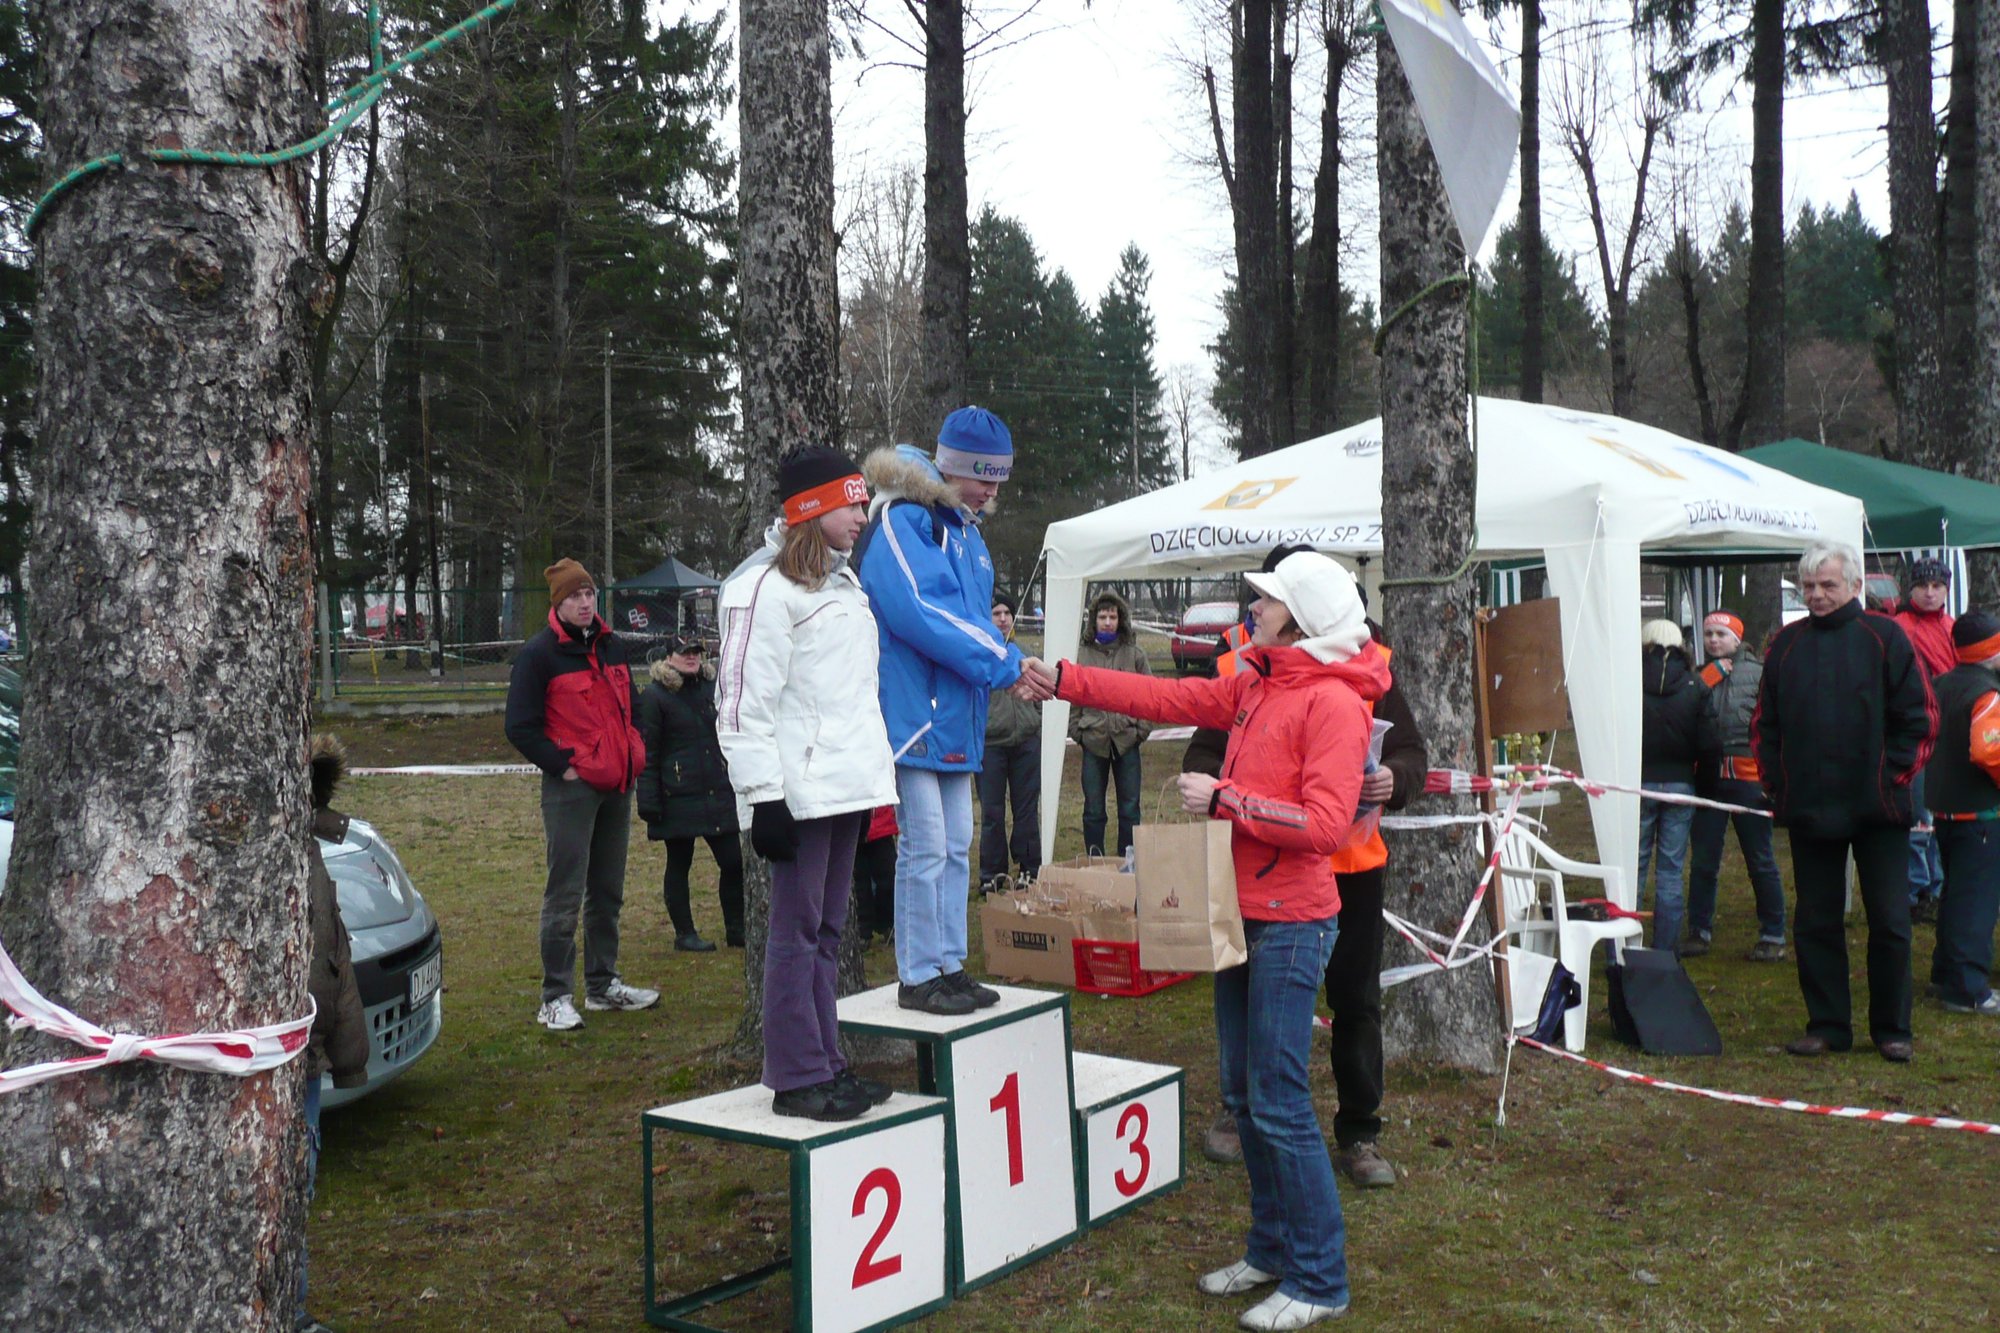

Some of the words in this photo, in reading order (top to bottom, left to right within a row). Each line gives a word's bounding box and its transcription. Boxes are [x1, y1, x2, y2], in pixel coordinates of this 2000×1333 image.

[989, 1070, 1025, 1187] 1
[1113, 1102, 1151, 1198] 3
[851, 1166, 902, 1291] 2
